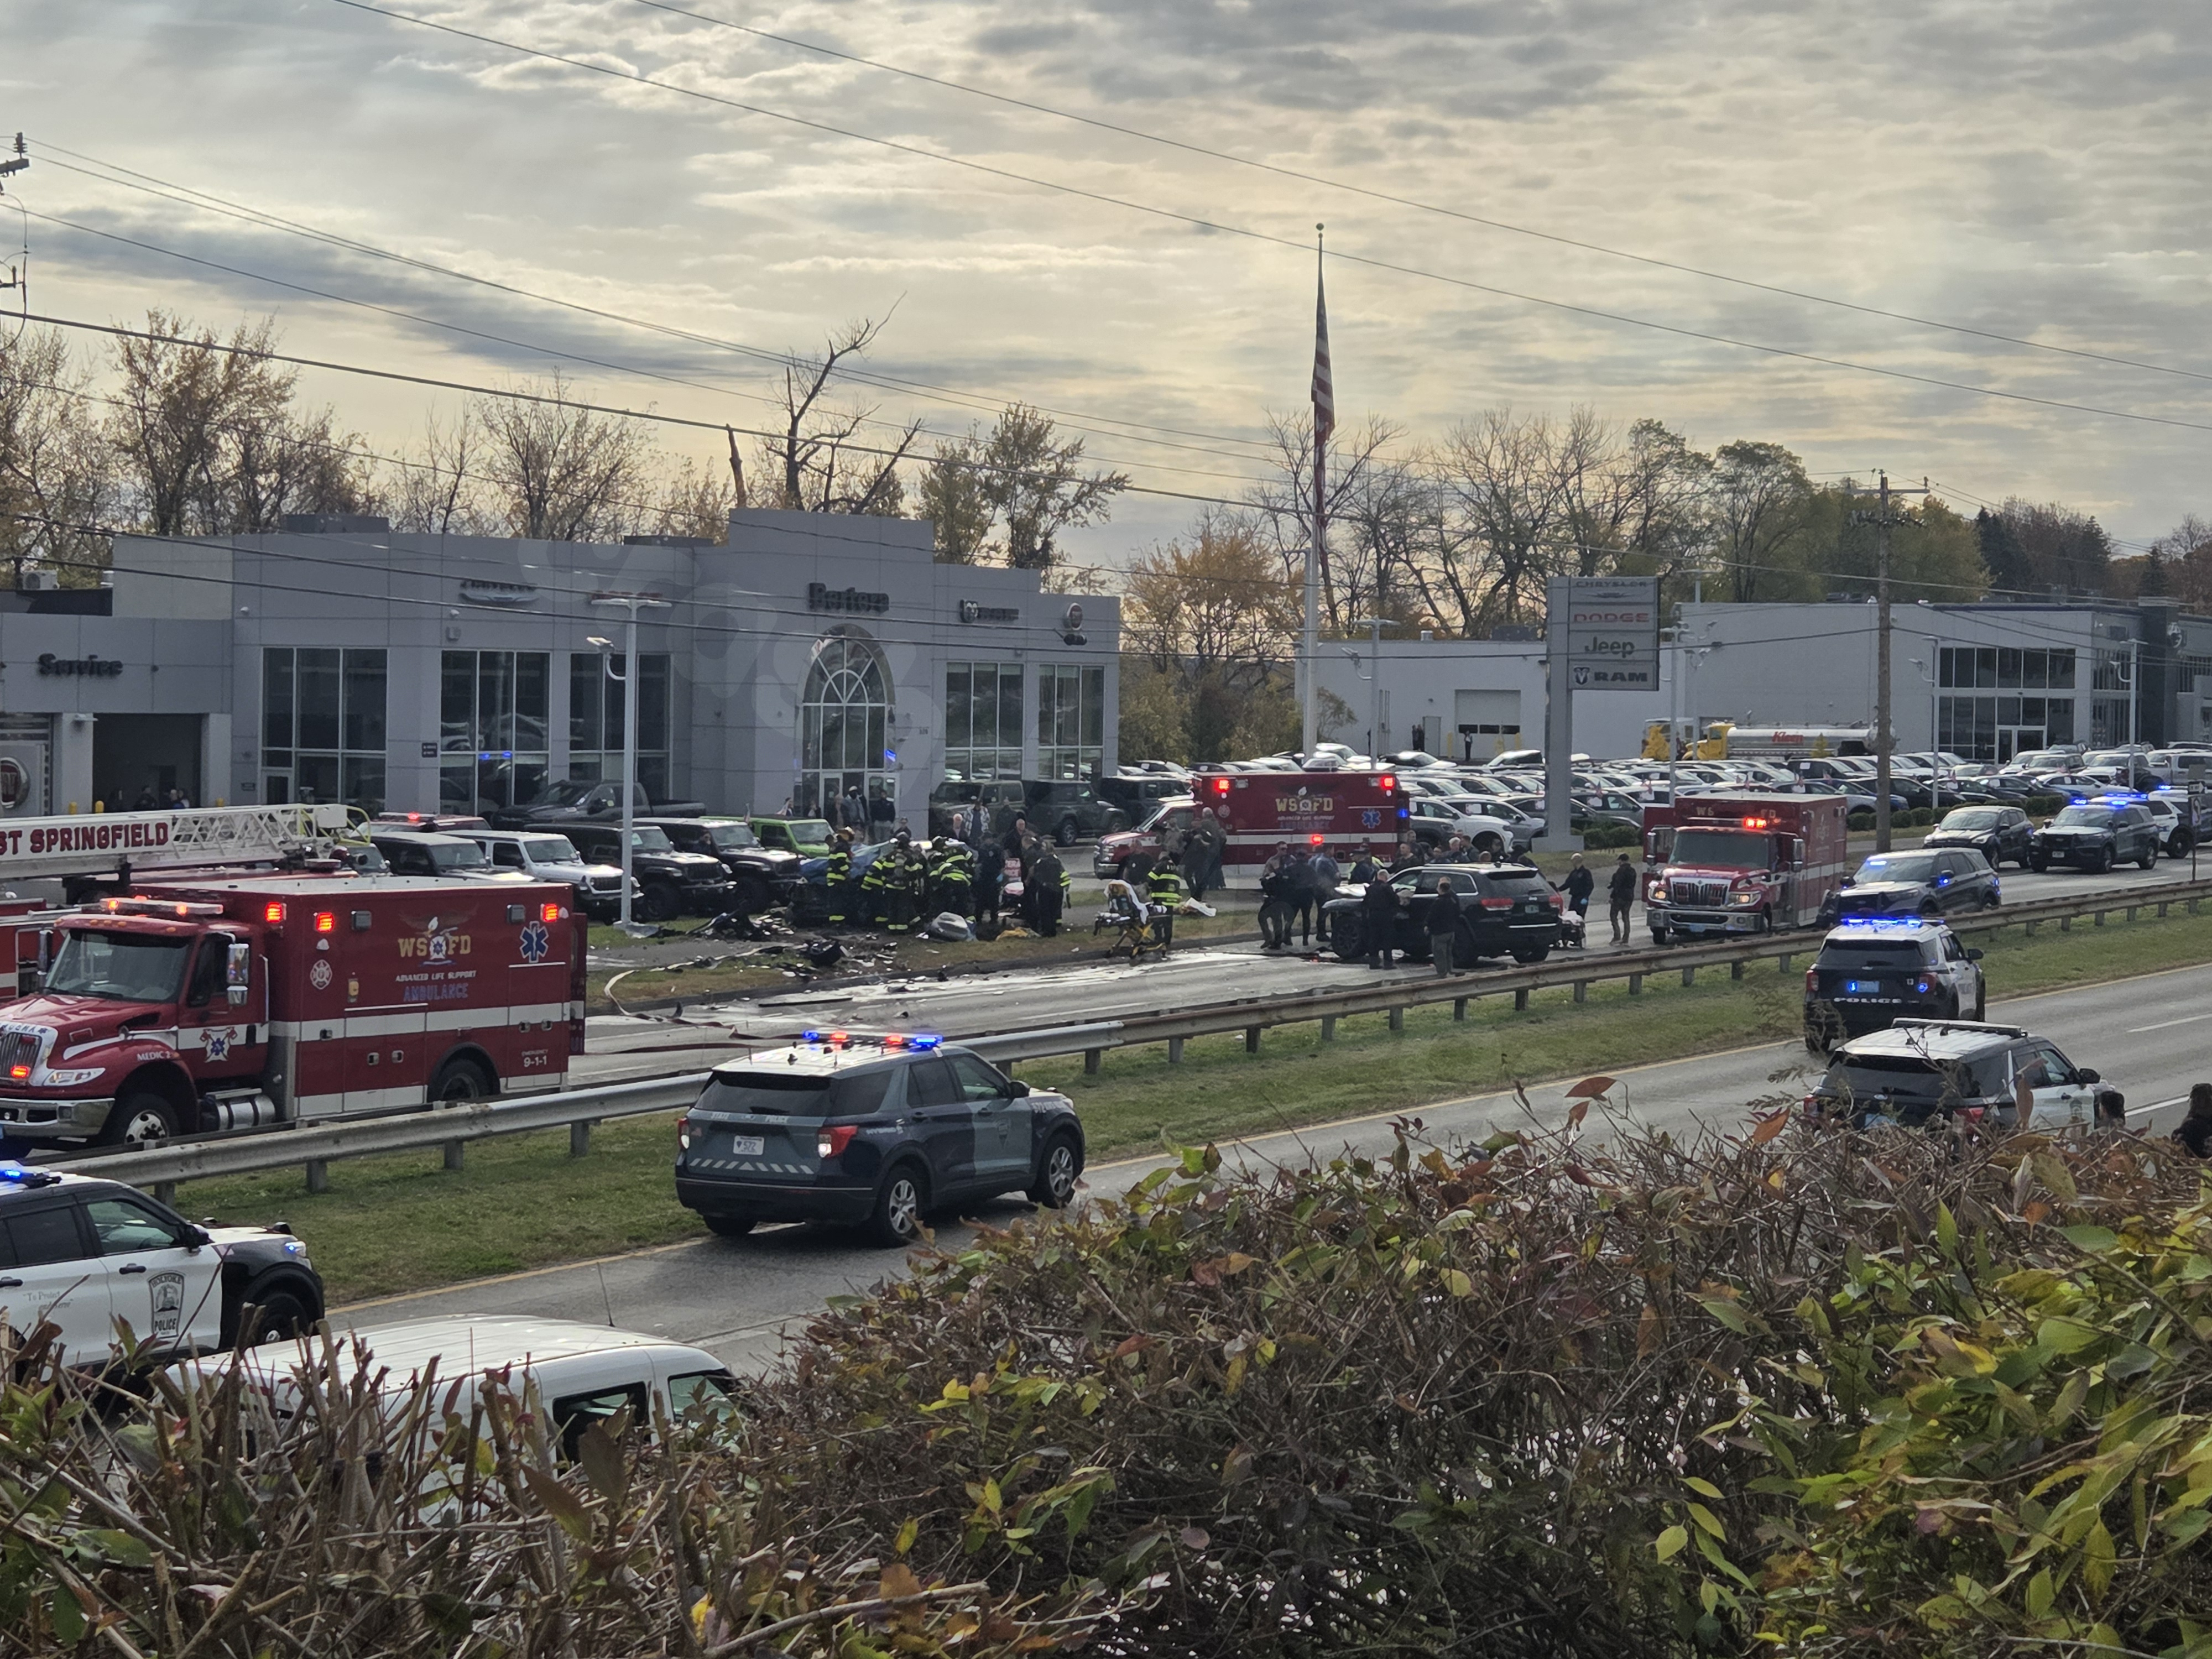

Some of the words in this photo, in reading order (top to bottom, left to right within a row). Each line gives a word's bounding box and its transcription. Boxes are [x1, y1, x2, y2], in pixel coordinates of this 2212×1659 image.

[1574, 613, 1649, 623] DODGE
[1585, 637, 1635, 658] Jeep
[39, 653, 123, 676] Service
[1594, 672, 1647, 682] RAM
[30, 822, 168, 853] SPRINGFIELD
[395, 973, 429, 982] ADVANCED
[447, 970, 477, 979] SUPPORT
[403, 983, 468, 1001] AMBULANCE
[137, 1051, 164, 1061] MEDIC
[524, 1055, 547, 1068] 9-1-1
[154, 1318, 176, 1332] POLICE
